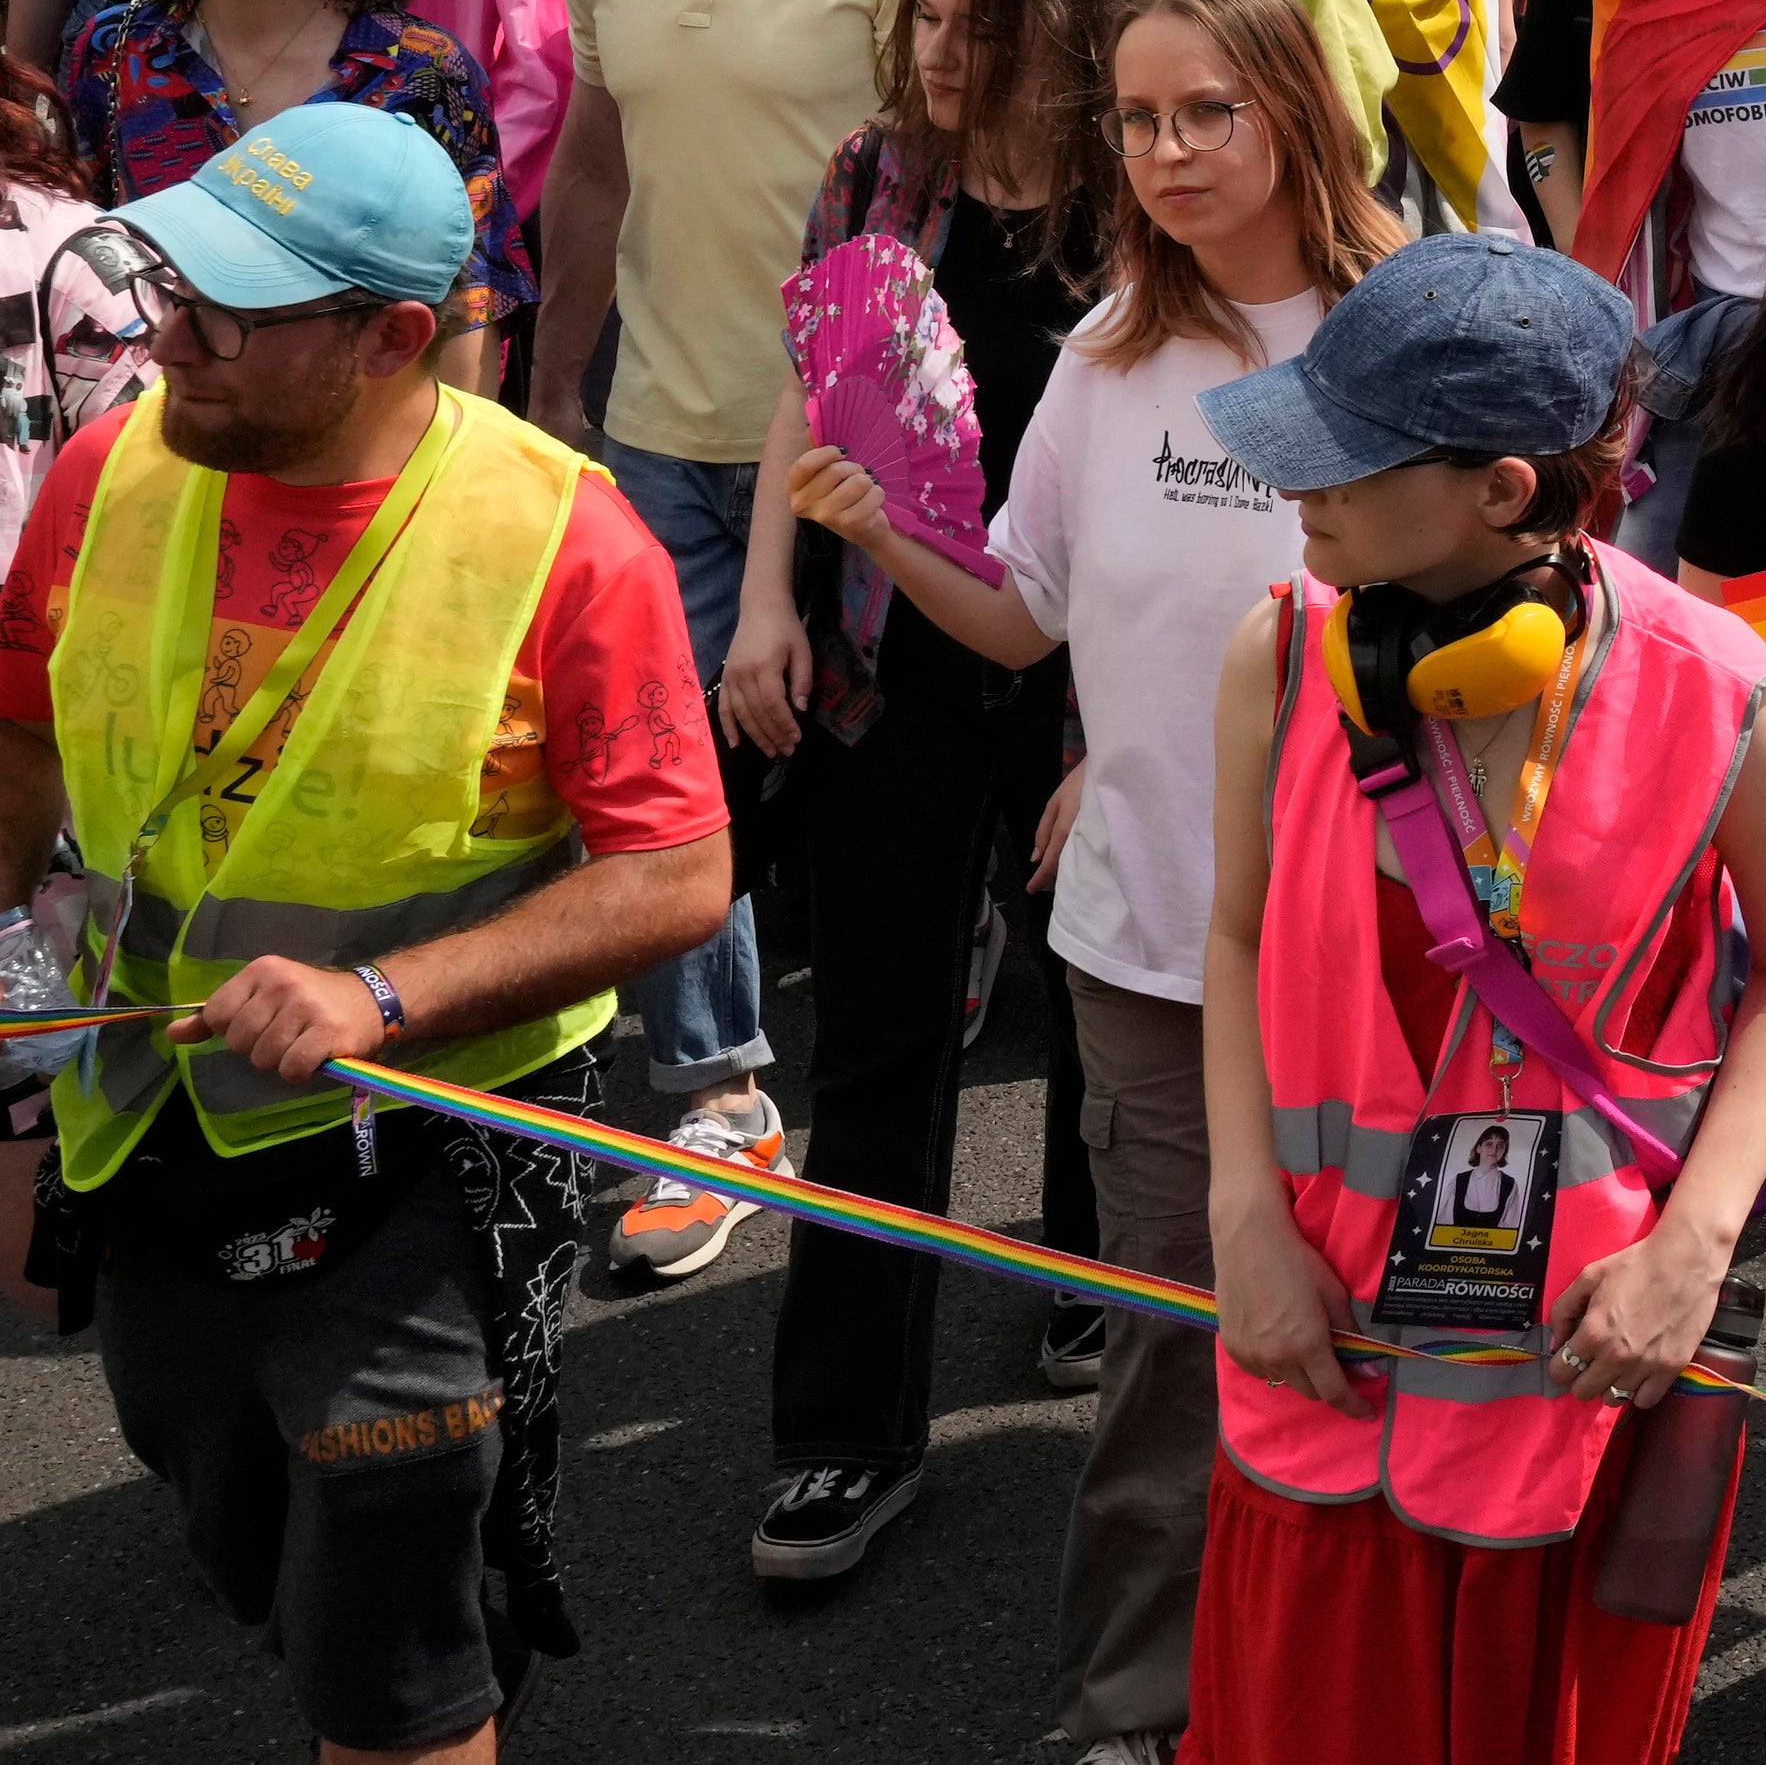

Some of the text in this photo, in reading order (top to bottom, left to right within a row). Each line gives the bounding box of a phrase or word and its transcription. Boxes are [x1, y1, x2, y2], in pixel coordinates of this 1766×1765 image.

[246, 136, 314, 191] Слава
[217, 152, 297, 217] Україні
[1417, 1263, 1514, 1277] KOORDYNATORSKA
[1450, 1255, 1487, 1265] OSOBA
[1396, 1276, 1446, 1291] PARADA
[1444, 1280, 1534, 1301] RÓWNOŚCI
